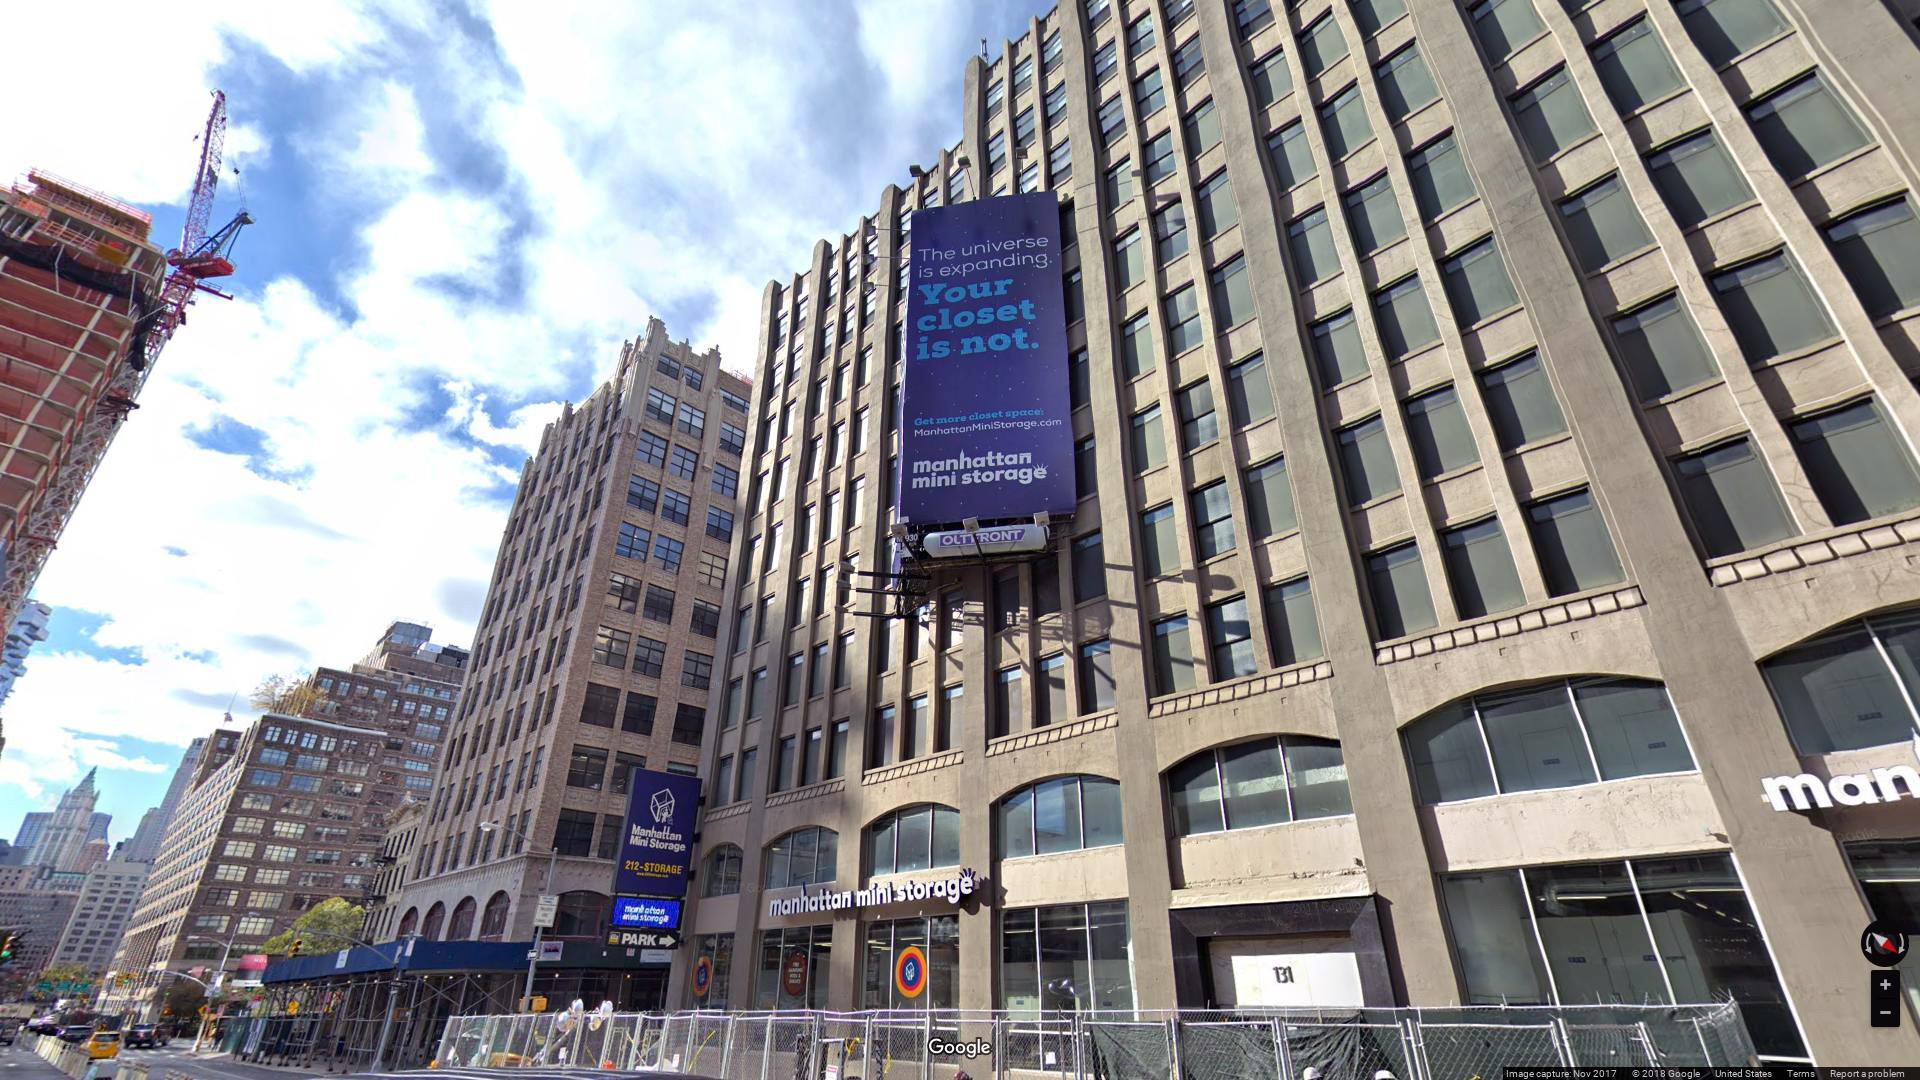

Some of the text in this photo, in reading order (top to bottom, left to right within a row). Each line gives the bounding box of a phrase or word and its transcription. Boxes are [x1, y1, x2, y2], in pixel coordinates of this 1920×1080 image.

[918, 236, 1049, 262] The universe
[919, 253, 1053, 278] is expanding.
[918, 278, 1014, 305] Your
[917, 299, 1036, 332] closet
[917, 328, 1039, 360] is not.
[914, 417, 934, 426] Get
[936, 414, 967, 424] more
[969, 411, 1002, 421] closet
[914, 418, 1063, 438] ManhattanMiniStorage.com
[912, 449, 1032, 474] manhattan
[911, 463, 1049, 489] mini storage
[1761, 727, 1920, 812] man
[629, 835, 686, 853] Mini Storage
[632, 823, 682, 841] Manhattan
[624, 860, 684, 875] 212-STORAGE
[769, 868, 976, 916] manhattan mini storage
[621, 933, 658, 946] PARK
[1273, 965, 1295, 984] 131
